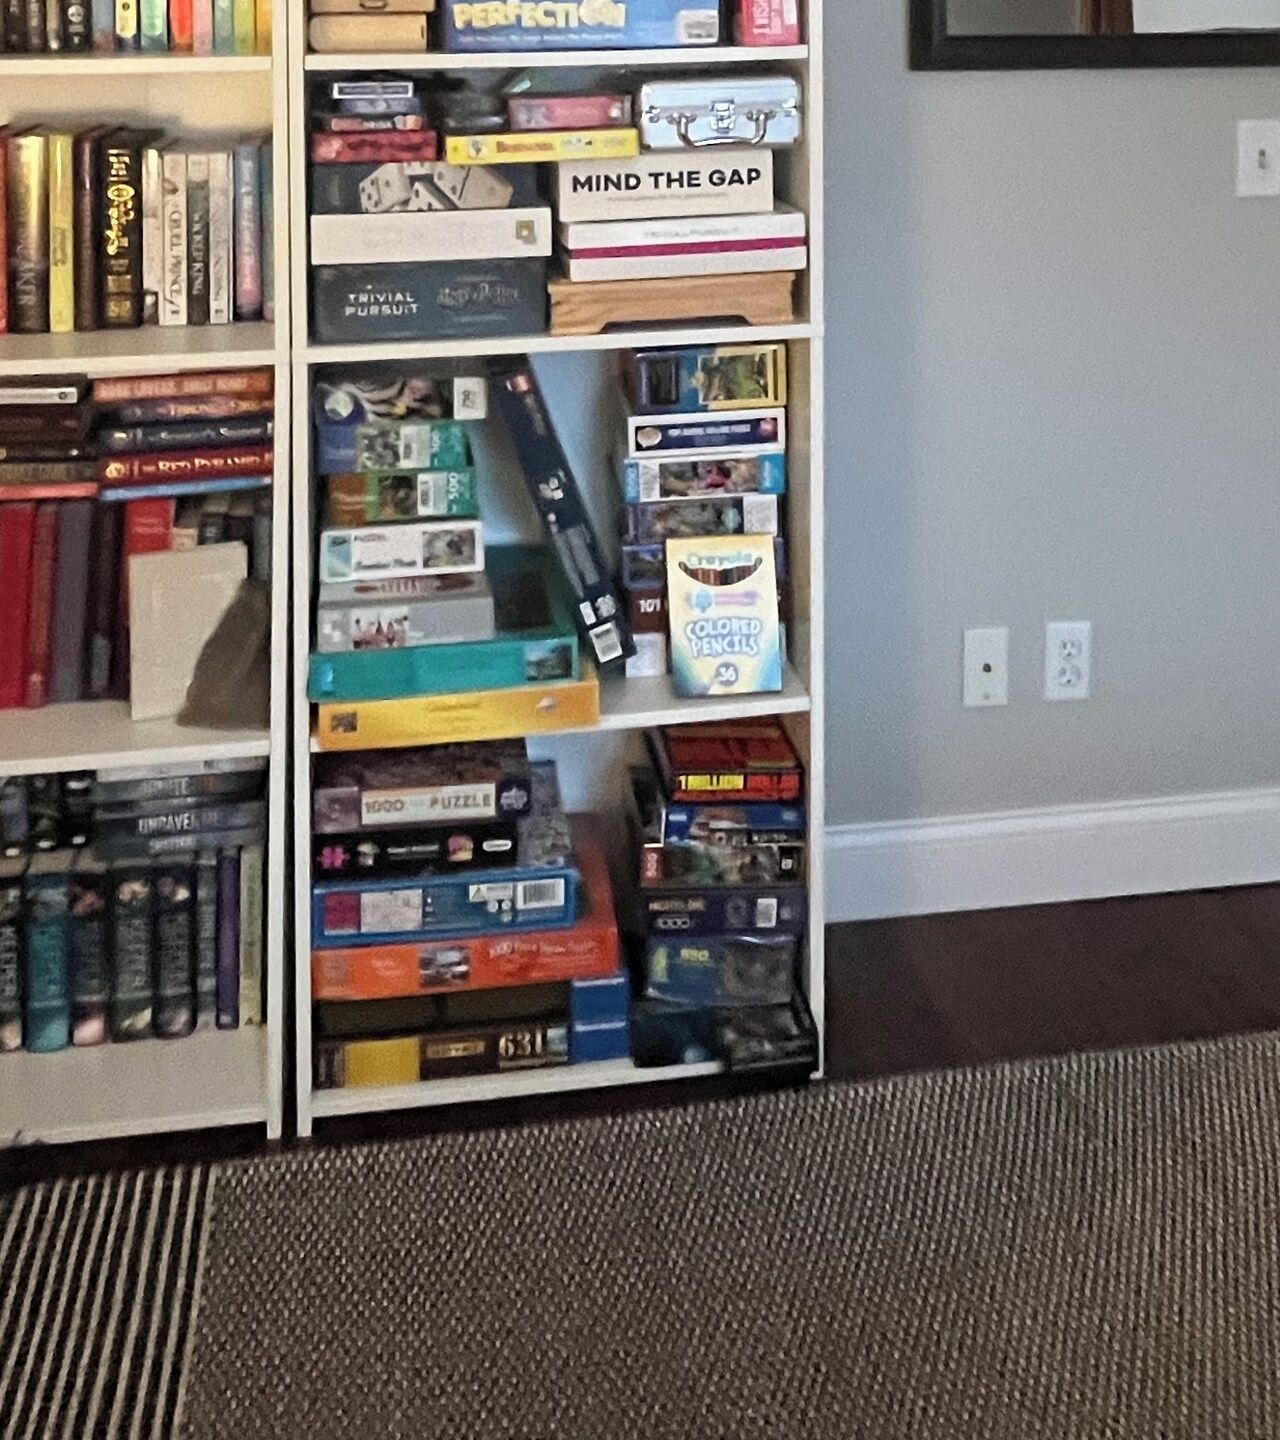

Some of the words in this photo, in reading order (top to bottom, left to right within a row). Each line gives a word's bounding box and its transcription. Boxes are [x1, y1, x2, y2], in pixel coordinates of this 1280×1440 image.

[572, 173, 641, 193] MIND
[648, 170, 702, 188] THE
[708, 167, 761, 187] GAP
[170, 210, 183, 251] CRUEL
[170, 255, 183, 298] PRINCE
[192, 262, 204, 295] KING
[345, 303, 419, 316] PURSUIT
[348, 293, 414, 304] TRIVIAL
[448, 472, 458, 500] 500
[686, 618, 760, 640] COLORED
[690, 635, 758, 657] PENCILS
[717, 666, 736, 682] 36
[363, 799, 404, 814] 1000
[430, 793, 492, 809] PUZZLE
[499, 1030, 543, 1057] 631
